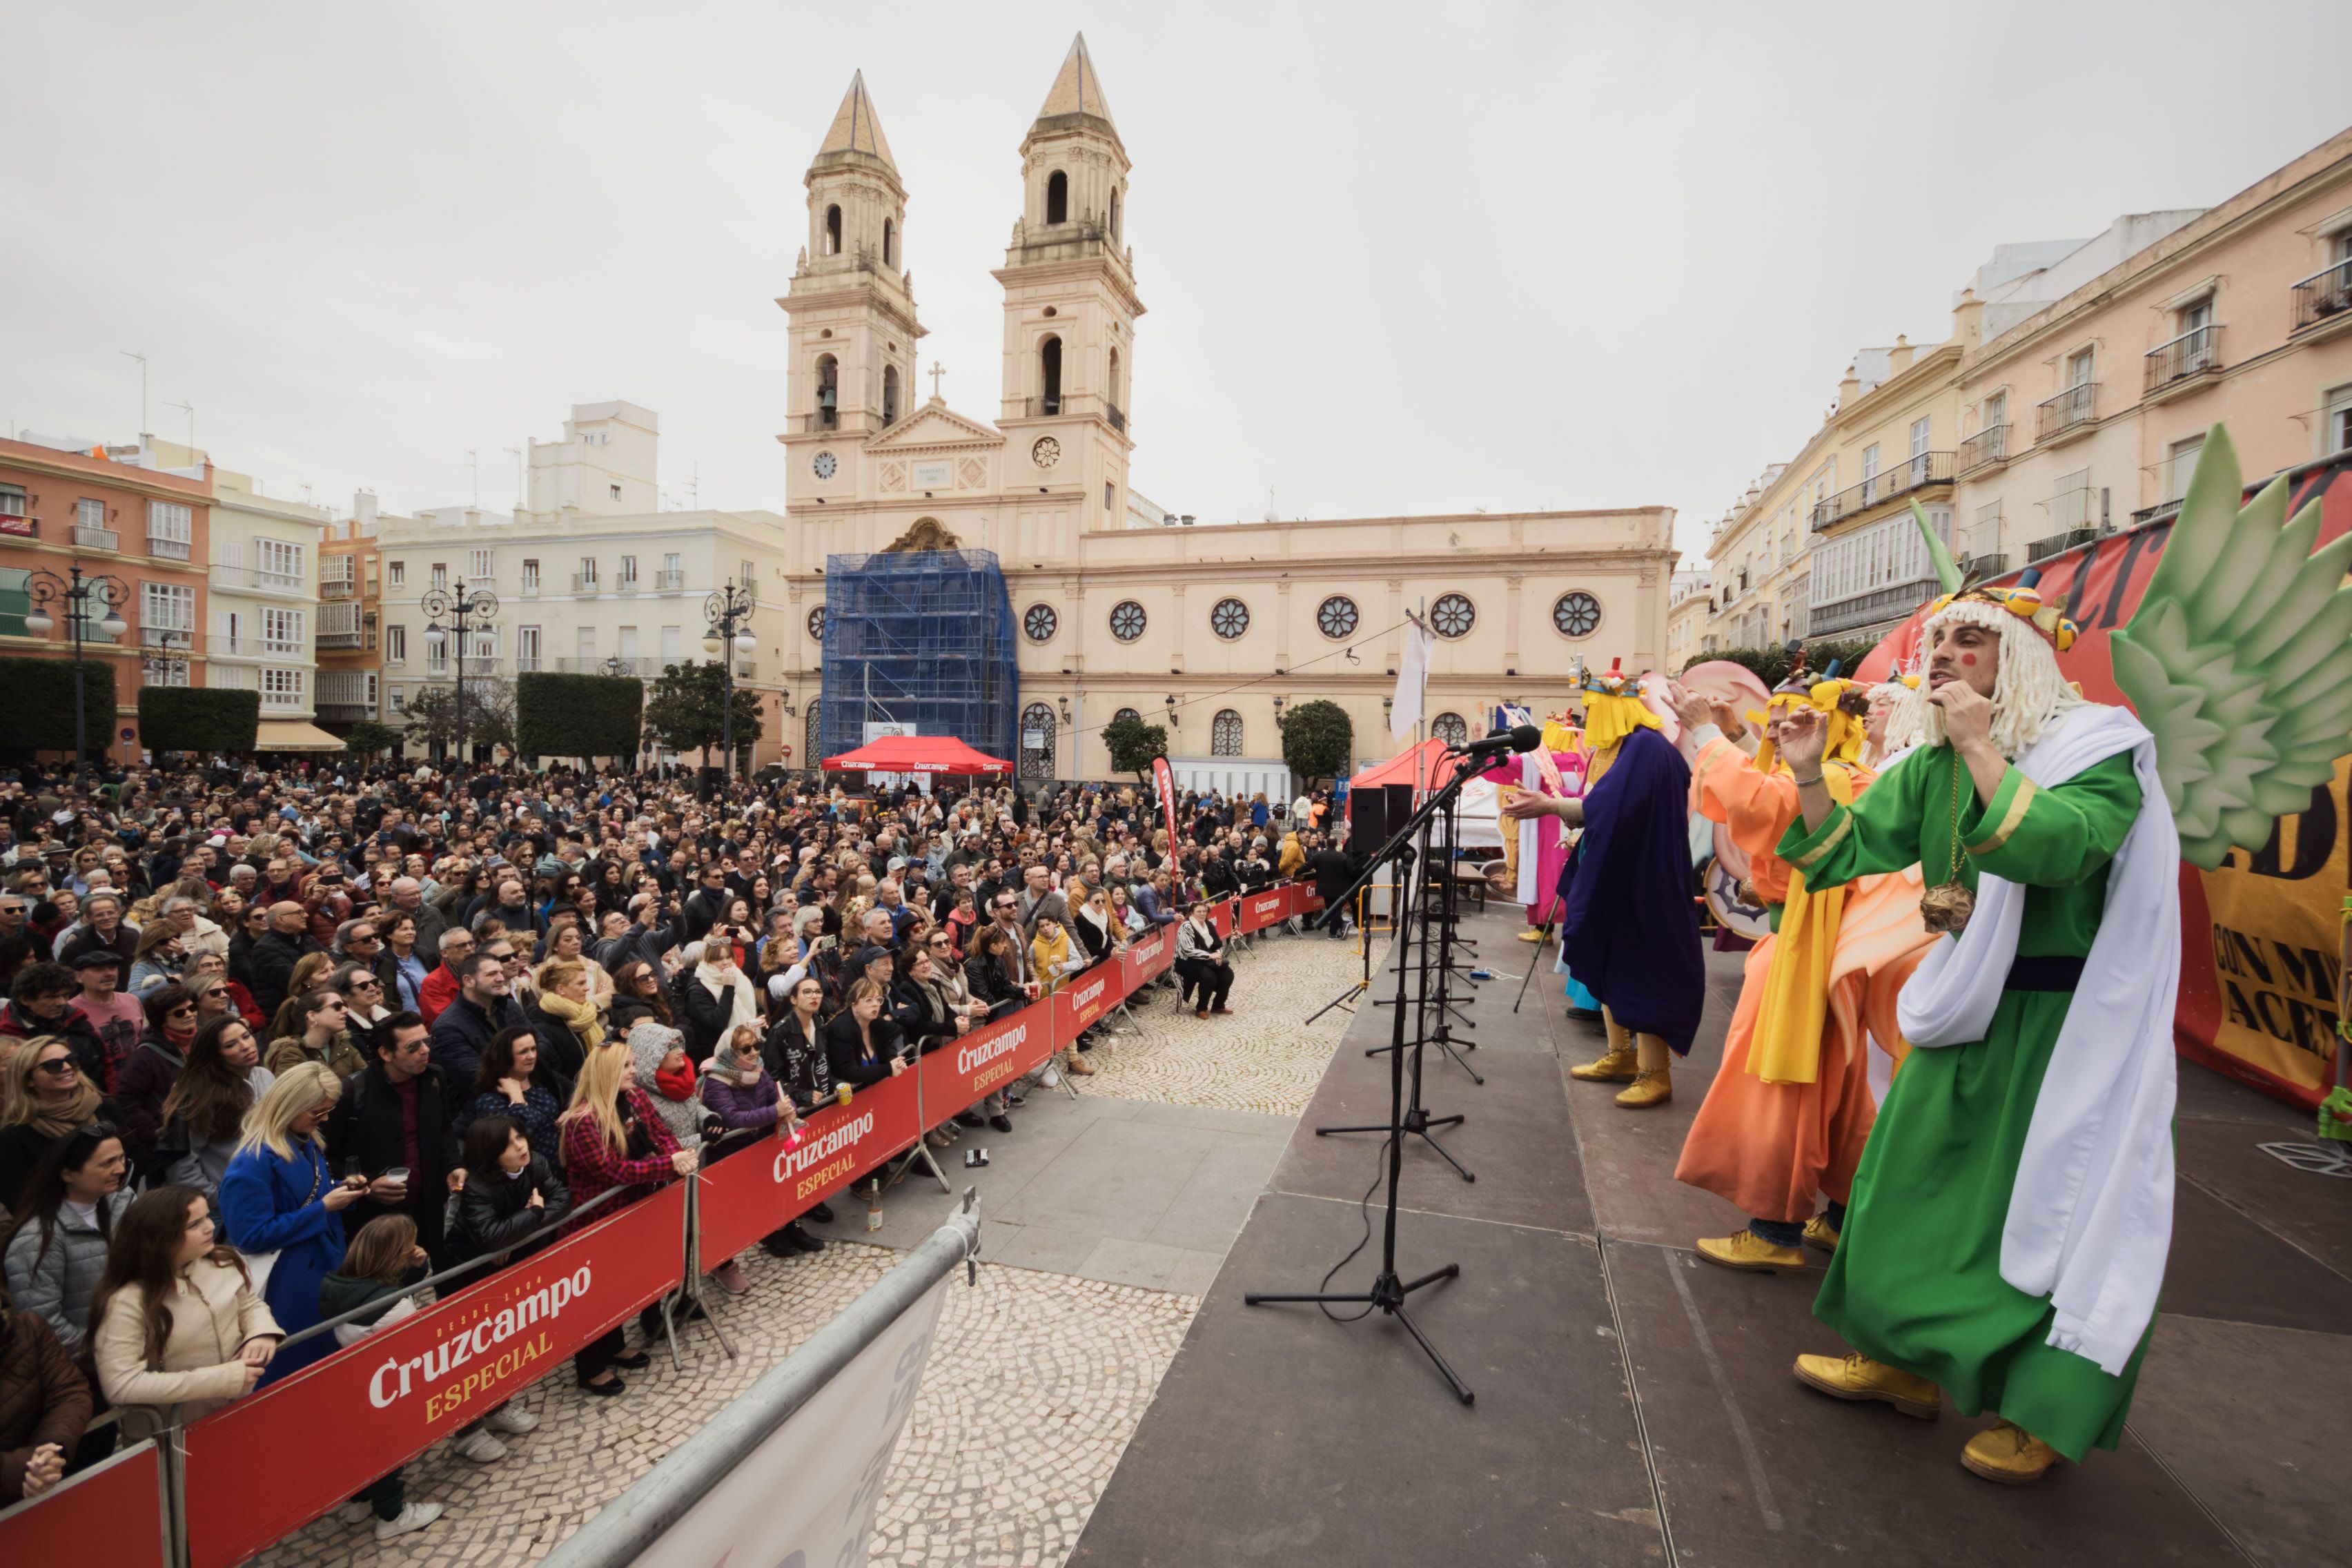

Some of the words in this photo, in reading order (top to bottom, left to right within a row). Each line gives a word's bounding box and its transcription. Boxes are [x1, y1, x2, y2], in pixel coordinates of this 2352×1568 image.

[841, 761, 876, 770] Cruzcampo
[914, 762, 950, 772] Cruzcampo
[1255, 898, 1280, 914] Cruzcampo
[1136, 939, 1164, 966] Cruzcampo
[2213, 923, 2274, 984] CON
[1072, 979, 1105, 1010] Cruzcampo
[1080, 1002, 1100, 1023] ESPECIAL
[957, 1023, 1027, 1075] Cruzcampo
[974, 1058, 1014, 1092] ESPECIAL
[773, 1112, 873, 1183] Cruzcampo
[796, 1153, 855, 1200] ESPECIAL
[437, 1303, 489, 1337] DESDE
[504, 1275, 541, 1302] 1904
[369, 1264, 591, 1409] Cruzcampo
[425, 1332, 553, 1424] ESPECIAL
